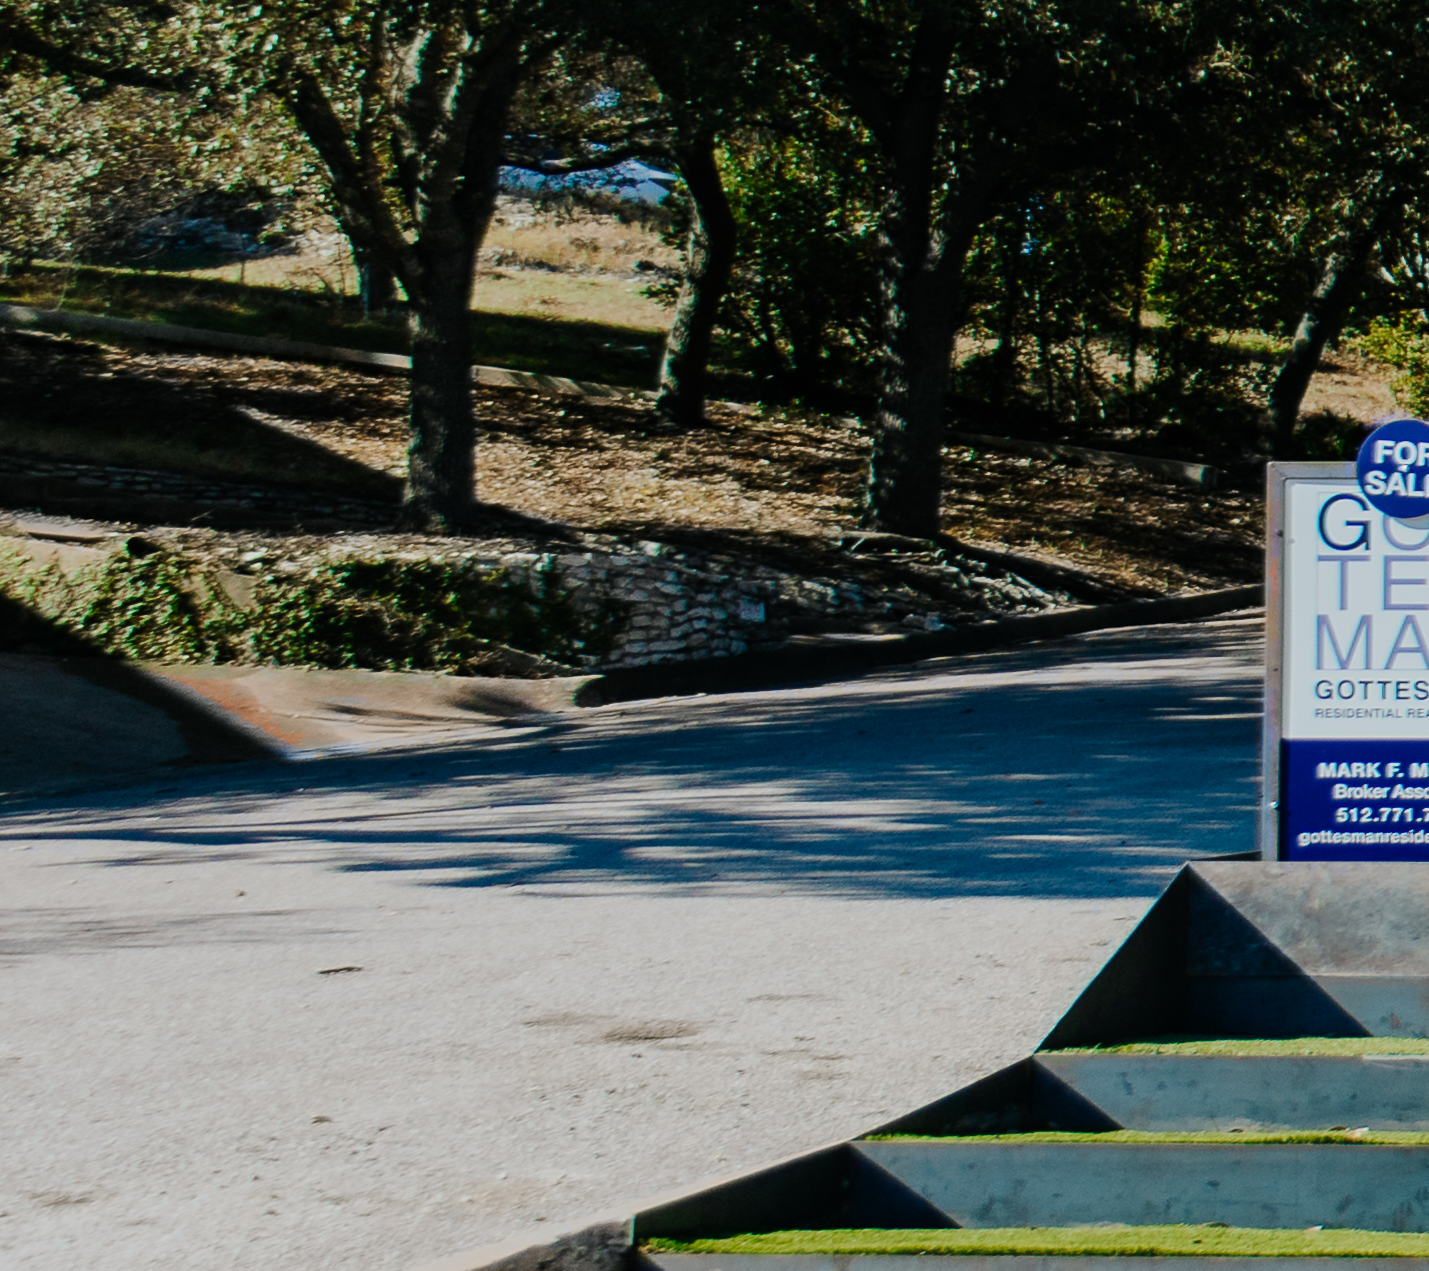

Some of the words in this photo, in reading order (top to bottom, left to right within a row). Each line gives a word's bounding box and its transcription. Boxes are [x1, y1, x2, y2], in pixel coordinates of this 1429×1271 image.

[1315, 708, 1402, 719] RESIDENTIAL
[1316, 762, 1381, 778] MARK
[1385, 762, 1404, 778] F.
[1332, 784, 1389, 799] Broker
